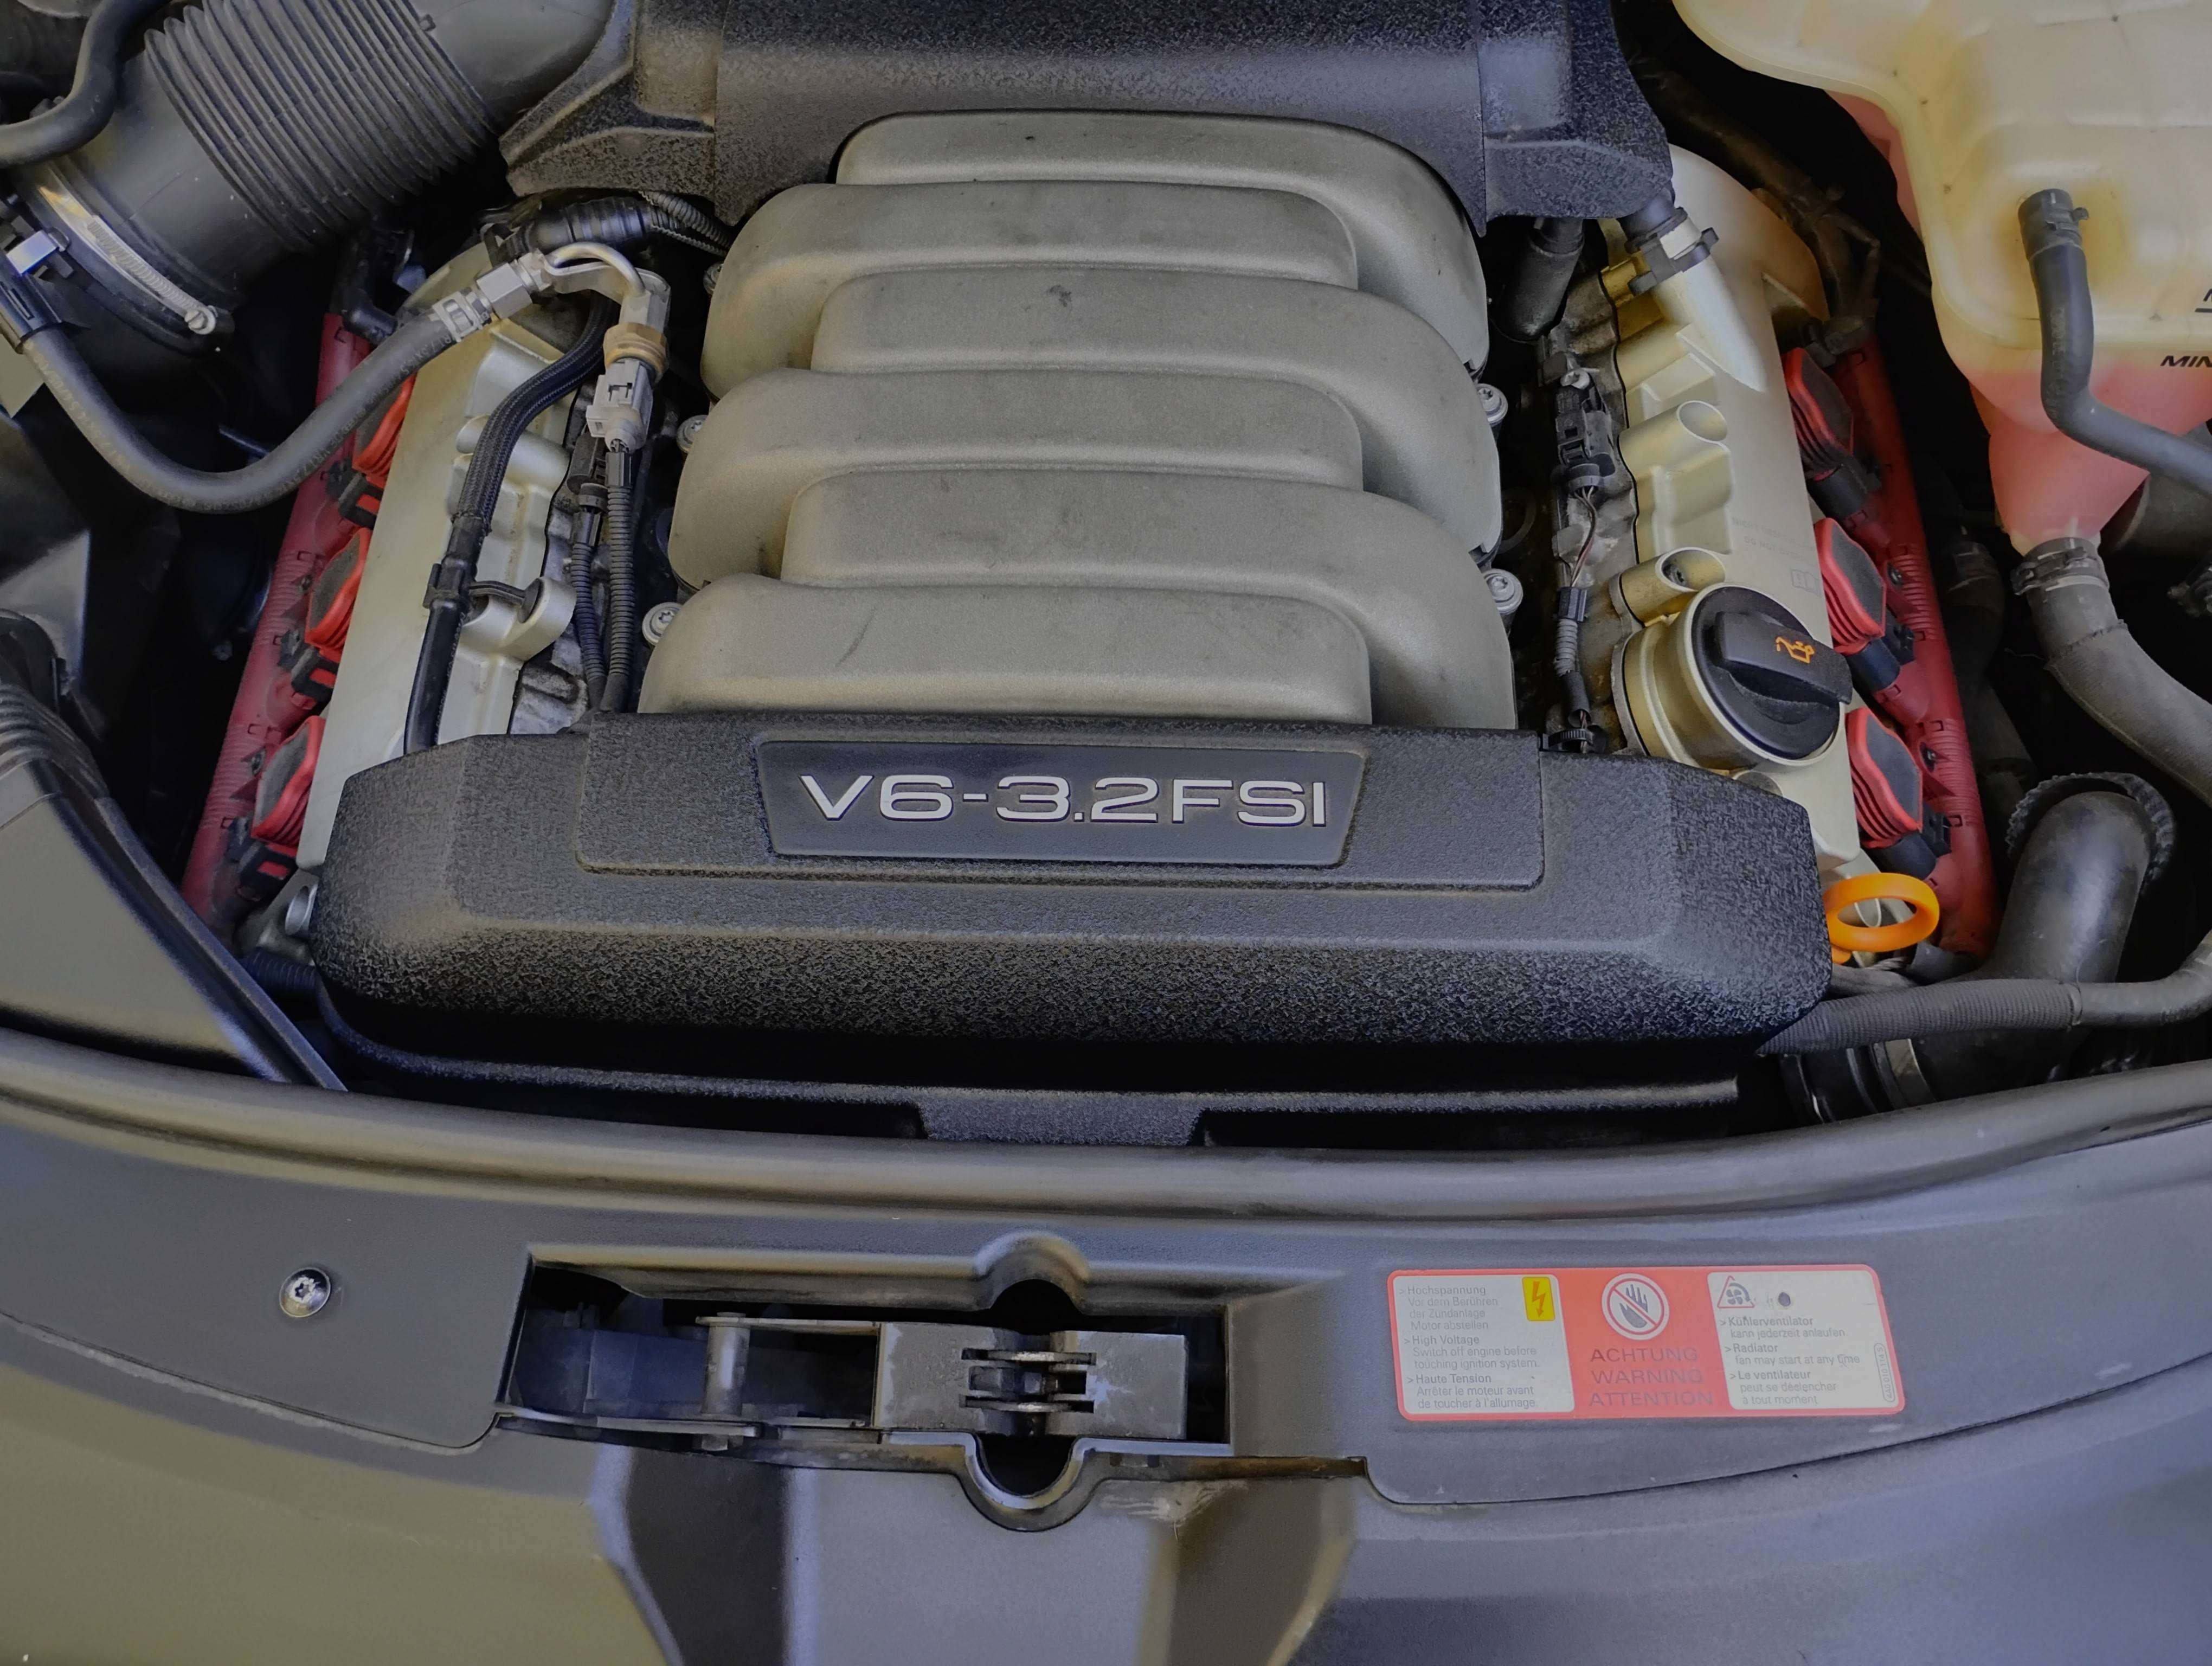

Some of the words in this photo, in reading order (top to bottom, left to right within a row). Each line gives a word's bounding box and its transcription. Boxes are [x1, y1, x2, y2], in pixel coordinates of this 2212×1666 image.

[2160, 356, 2212, 368] MIN
[800, 774, 1327, 828] V6-3.2FSI
[1407, 1286, 1486, 1296] Hochspannung
[1409, 1298, 1424, 1306] Vor
[1427, 1297, 1449, 1306] dem
[1410, 1309, 1425, 1318] der
[1411, 1321, 1441, 1330] Motor
[1444, 1321, 1488, 1330] abstellen
[1731, 1330, 1754, 1338] kann
[1757, 1329, 1800, 1340] jederzeit
[1412, 1335, 1436, 1347] High
[1439, 1335, 1480, 1346] Voltage
[1413, 1347, 1448, 1356] Switch
[1450, 1347, 1464, 1356] off
[1467, 1347, 1501, 1358] engine
[1504, 1346, 1536, 1355] before
[1733, 1343, 1778, 1353] Radiator
[1590, 1347, 1698, 1362] ACHTUNG
[1414, 1360, 1457, 1370] touching
[1461, 1359, 1497, 1370] ignition
[1735, 1356, 1751, 1365] fan
[1754, 1357, 1775, 1366] may
[1779, 1356, 1802, 1364] start
[1804, 1356, 1815, 1364] at
[1817, 1356, 1834, 1366] any
[1416, 1374, 1447, 1383] Haute
[1450, 1374, 1491, 1383] Tension
[1591, 1369, 1703, 1384] WARNING
[1738, 1370, 1751, 1380] Le
[1753, 1370, 1811, 1380] ventilateur
[1417, 1386, 1452, 1396] Arrêter
[1455, 1386, 1464, 1395] le
[1467, 1386, 1503, 1395] moteur
[1507, 1386, 1534, 1395] avant
[1740, 1384, 1763, 1394] peut
[1766, 1384, 1778, 1392] se
[1418, 1399, 1431, 1408] de
[1434, 1399, 1472, 1408] toucher
[1475, 1399, 1481, 1408] à
[1589, 1391, 1713, 1406] ATTENTION
[1751, 1395, 1771, 1405] tout
